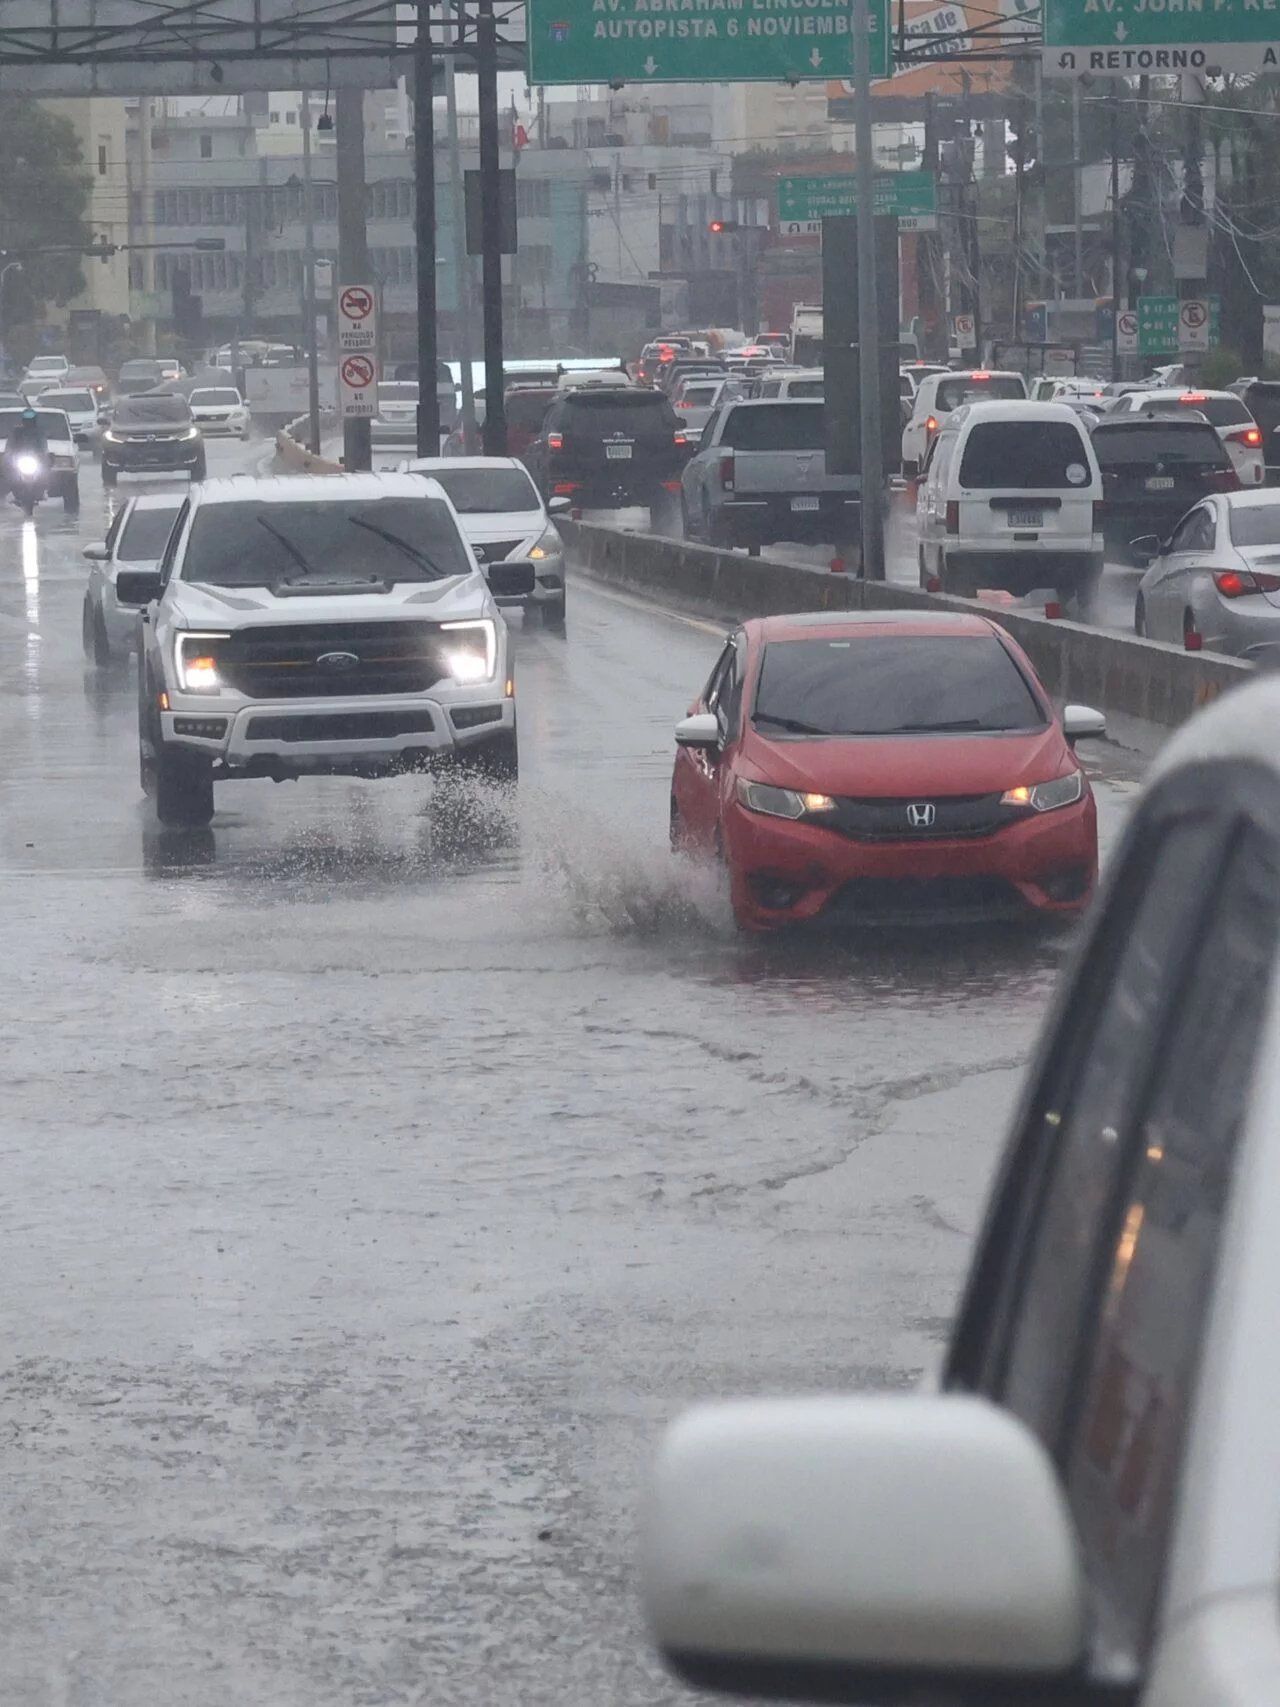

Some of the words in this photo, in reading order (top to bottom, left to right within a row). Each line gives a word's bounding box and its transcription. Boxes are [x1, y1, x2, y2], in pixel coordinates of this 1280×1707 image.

[593, 18, 718, 39] AUTOPISTA
[726, 18, 739, 37] 6
[747, 14, 878, 36] NOVIEMBE
[1090, 49, 1206, 69] RETORNO
